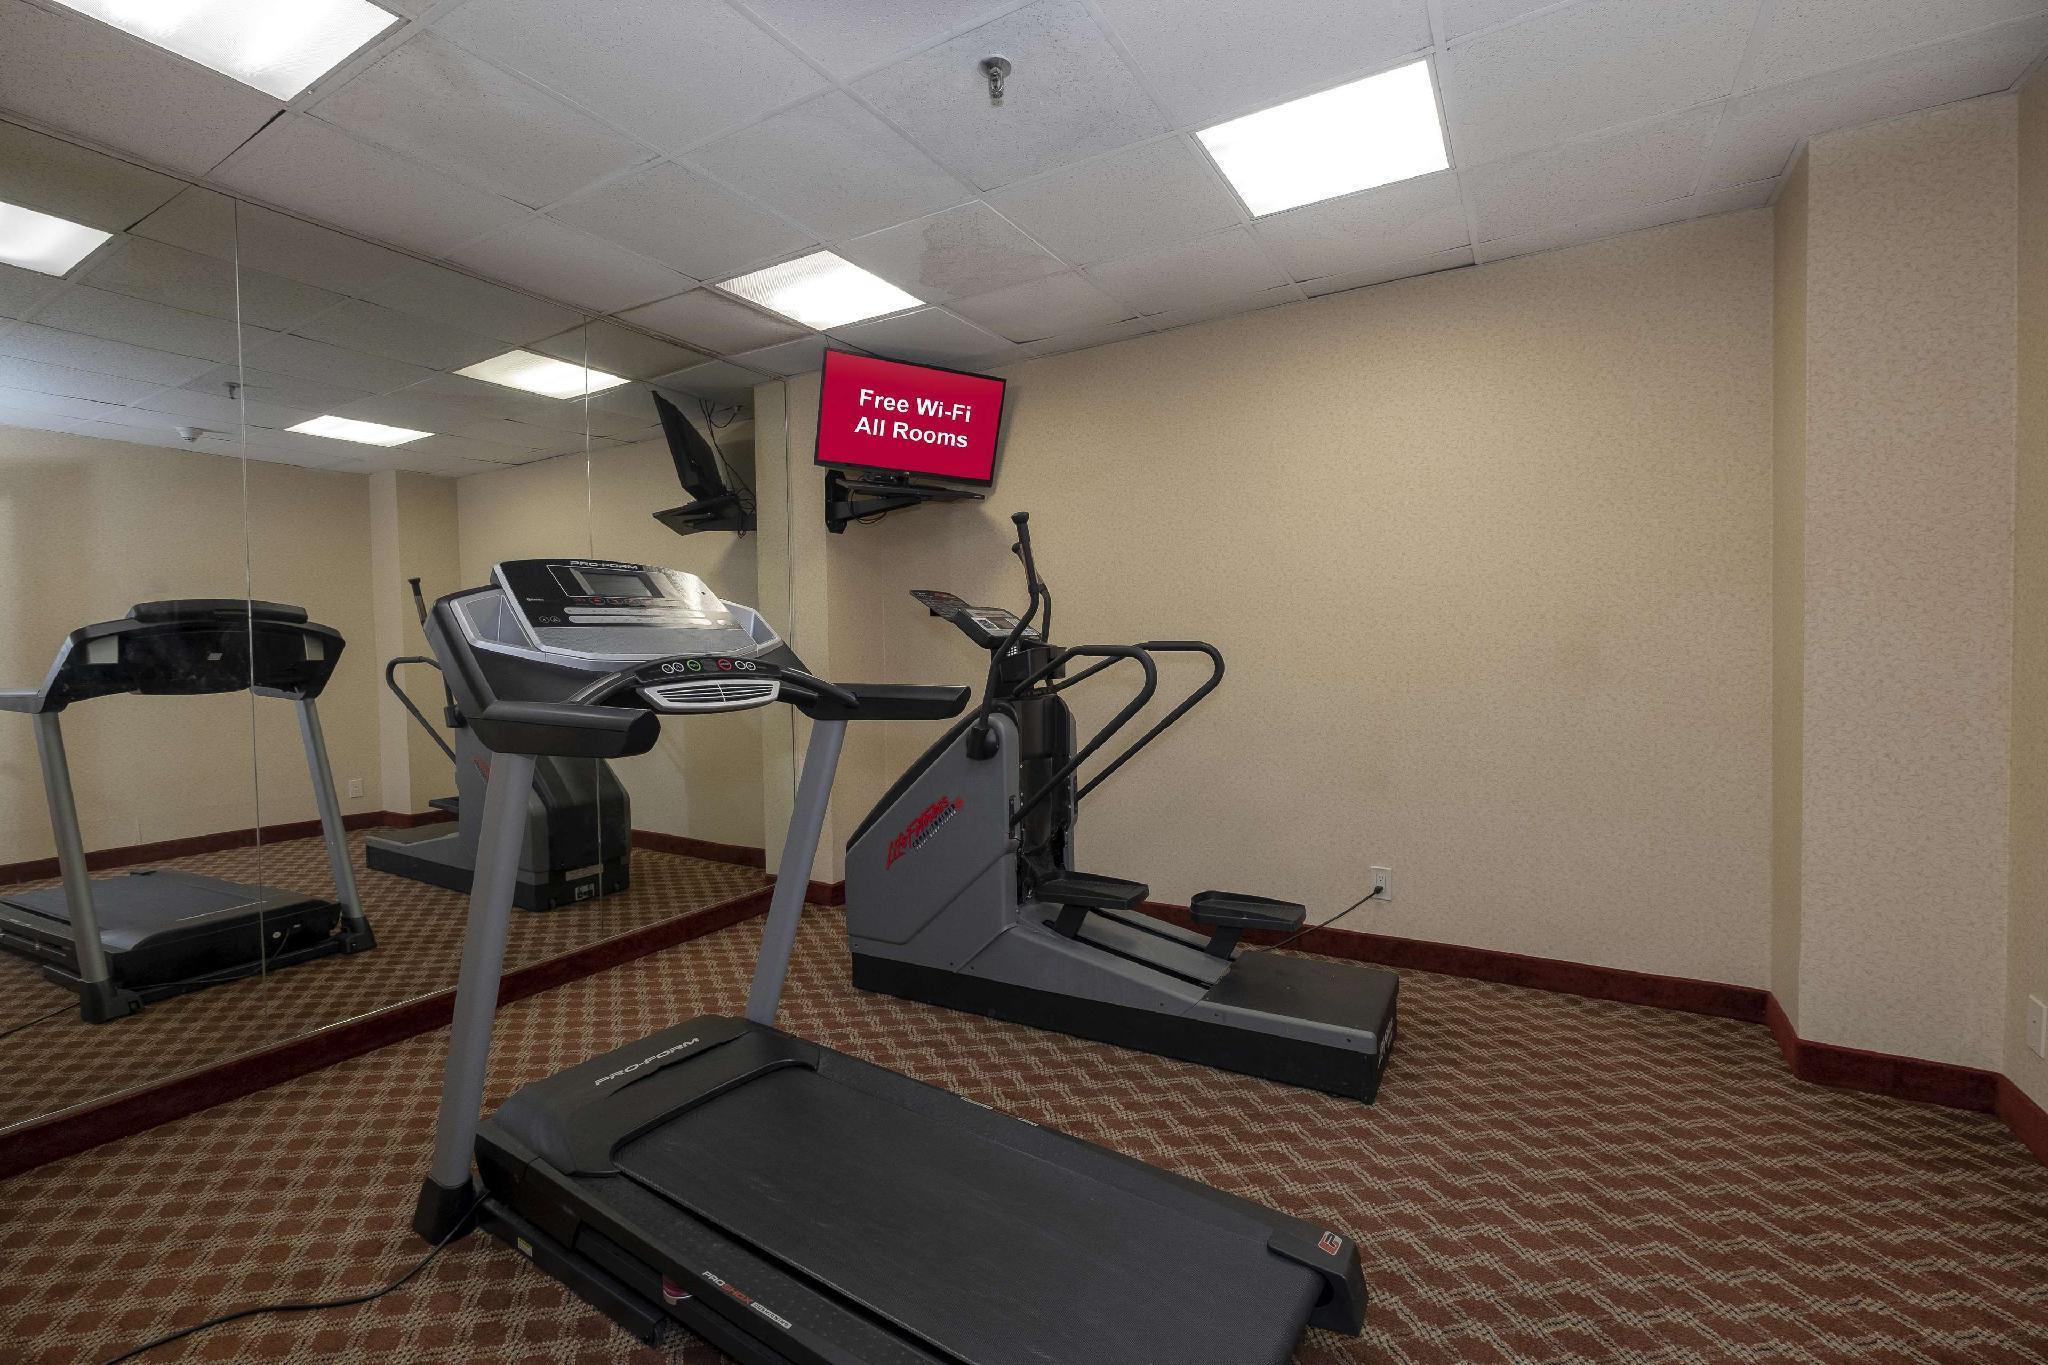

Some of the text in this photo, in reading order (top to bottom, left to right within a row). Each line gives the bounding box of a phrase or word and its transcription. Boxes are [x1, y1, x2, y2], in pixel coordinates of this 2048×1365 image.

[859, 388, 972, 423] Free Wi-Fi
[854, 416, 969, 448] All Rooms
[569, 560, 639, 570] PRO-FORM
